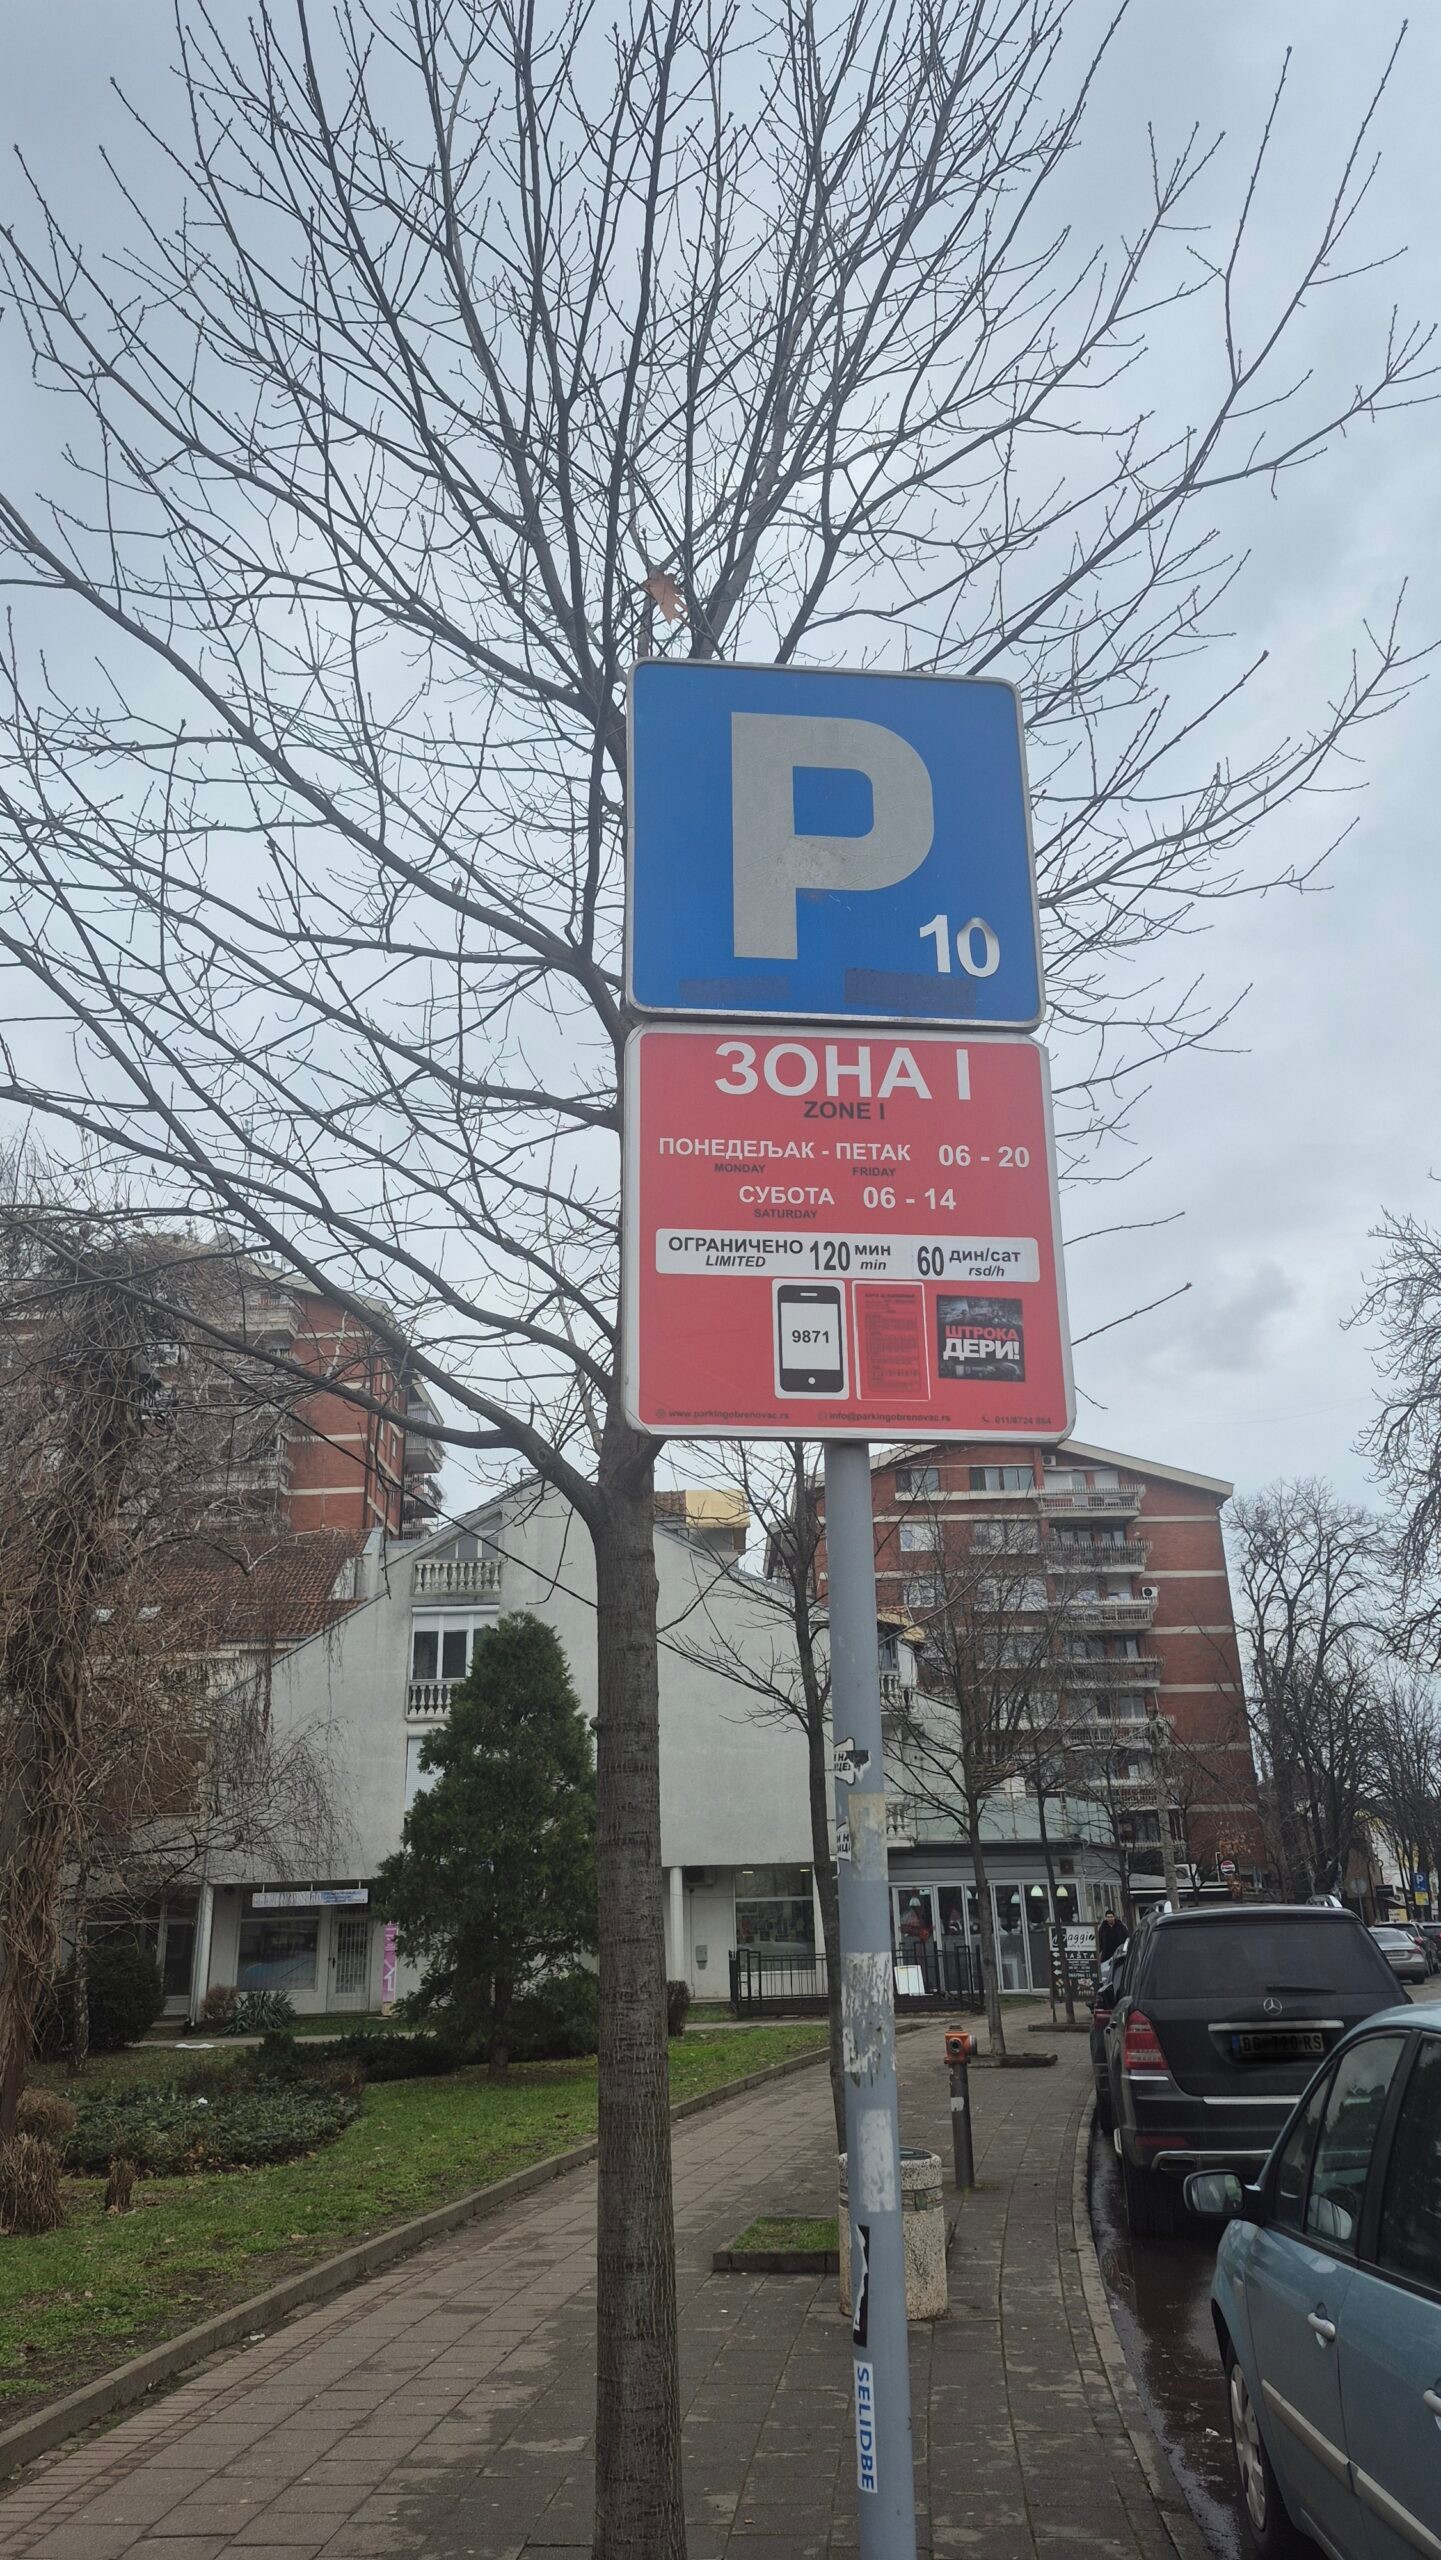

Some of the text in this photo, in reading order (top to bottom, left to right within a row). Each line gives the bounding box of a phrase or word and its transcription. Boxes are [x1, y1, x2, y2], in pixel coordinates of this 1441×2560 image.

[731, 712, 934, 960] P
[919, 914, 1000, 978] 10
[715, 1041, 971, 1100] ЗОНА I
[804, 1101, 885, 1120] ZONE I
[659, 1137, 814, 1160] ПОНЕДЕЉАК
[836, 1142, 911, 1161] ПЕТАК
[938, 1145, 970, 1167] 06
[998, 1146, 1030, 1168] 20
[714, 1163, 765, 1174] MONDAY
[852, 1167, 896, 1177] FRIDAY
[739, 1186, 835, 1205] СУБОТА
[863, 1187, 896, 1209] 06
[924, 1188, 956, 1210] 14
[754, 1208, 818, 1219] SATURDAY
[668, 1236, 803, 1255] ОГРАНИЧЕНО
[809, 1240, 850, 1272] 120
[916, 1246, 944, 1277] 60
[948, 1247, 1021, 1264] дин/сат
[705, 1254, 766, 1268] LIMITED
[860, 1261, 887, 1271] min
[968, 1265, 1005, 1277] rsd/h
[791, 1329, 829, 1344] 9871
[945, 1325, 1019, 1341] ШТРОКА
[943, 1338, 1020, 1361] ДЕРИ!
[1416, 1874, 1424, 1884] P
[857, 2366, 875, 2490] SELIDBE
